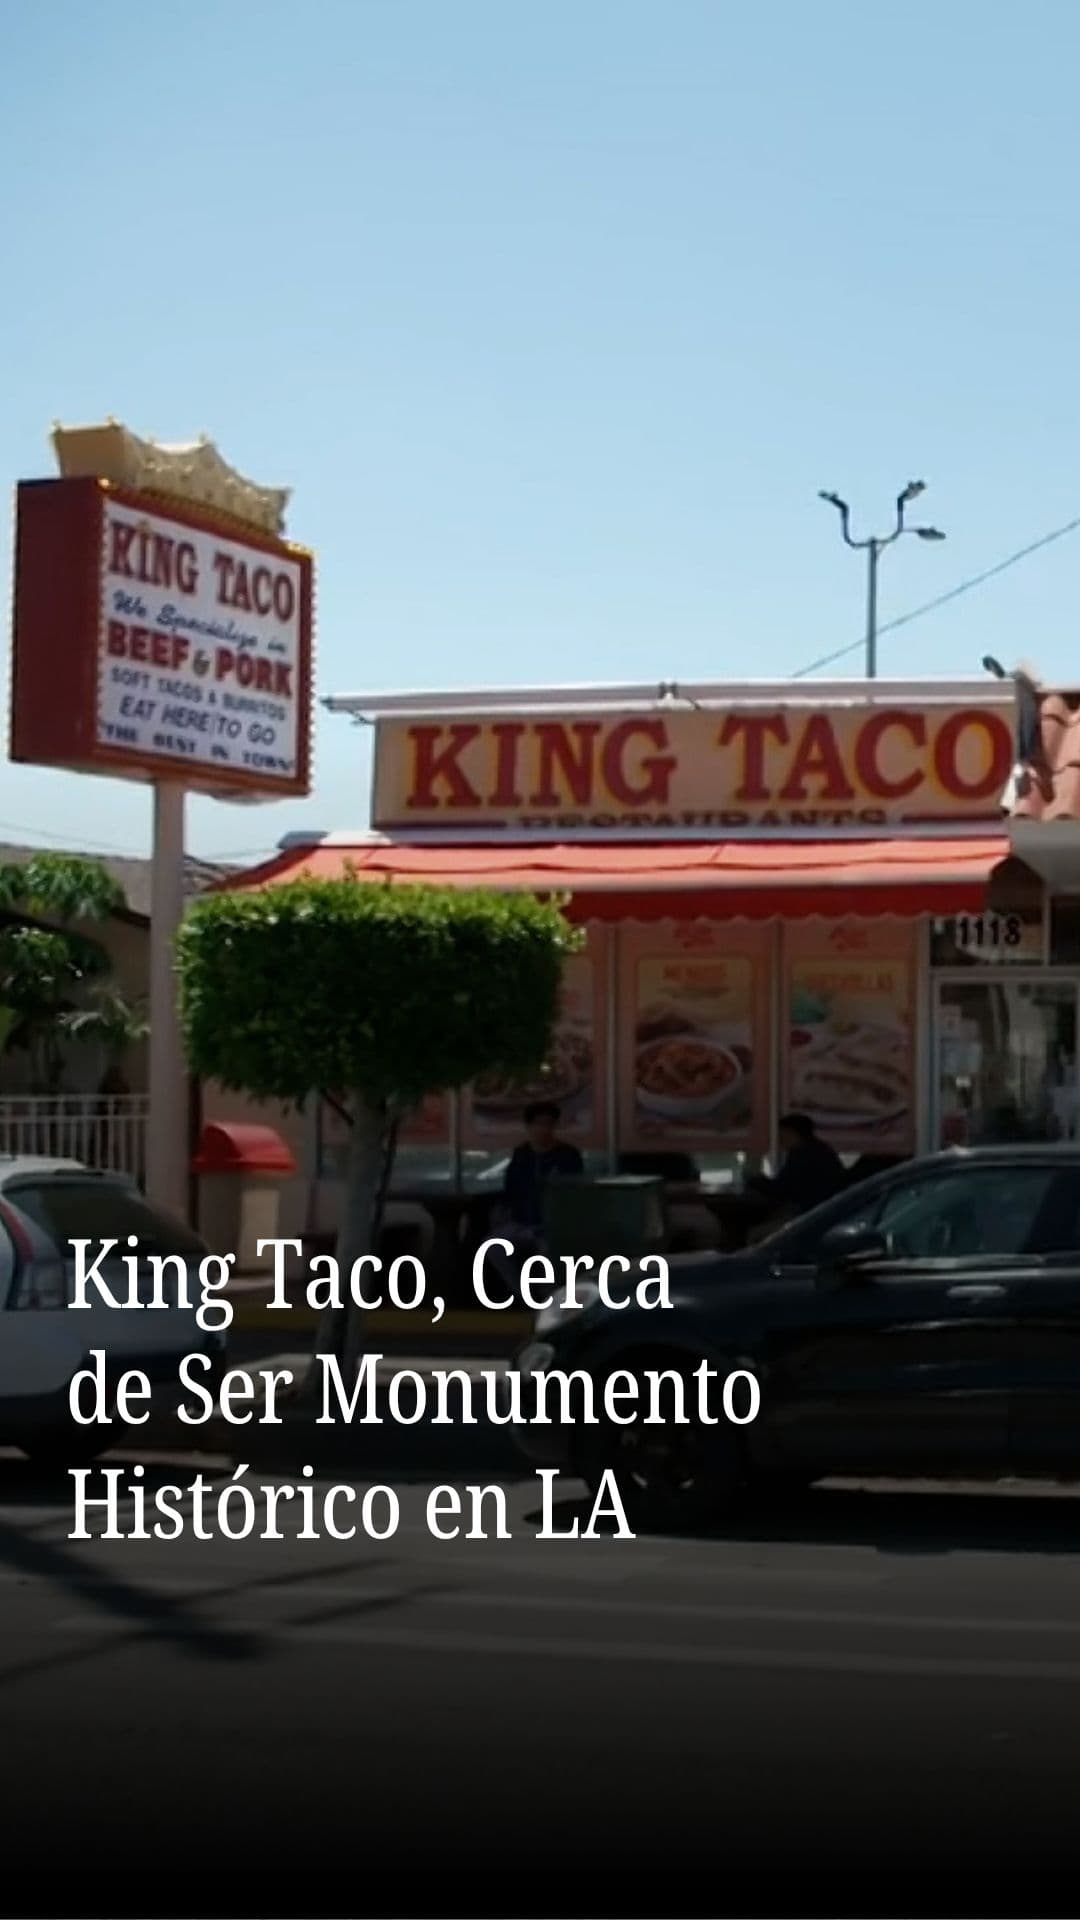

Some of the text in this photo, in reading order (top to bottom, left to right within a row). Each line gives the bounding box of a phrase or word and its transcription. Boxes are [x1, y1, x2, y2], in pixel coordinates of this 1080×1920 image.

[109, 521, 295, 622] KING TACO
[108, 620, 189, 670] BEEF
[215, 647, 293, 698] PORK
[112, 666, 151, 689] SOFT
[157, 678, 203, 704] TACOS
[222, 693, 287, 721] BURRITOS
[119, 695, 276, 746] EAT HERE TO GO
[105, 724, 137, 742] THE
[152, 733, 197, 753] BEST
[406, 709, 1013, 808] KING TACO
[958, 916, 1021, 945] 1118
